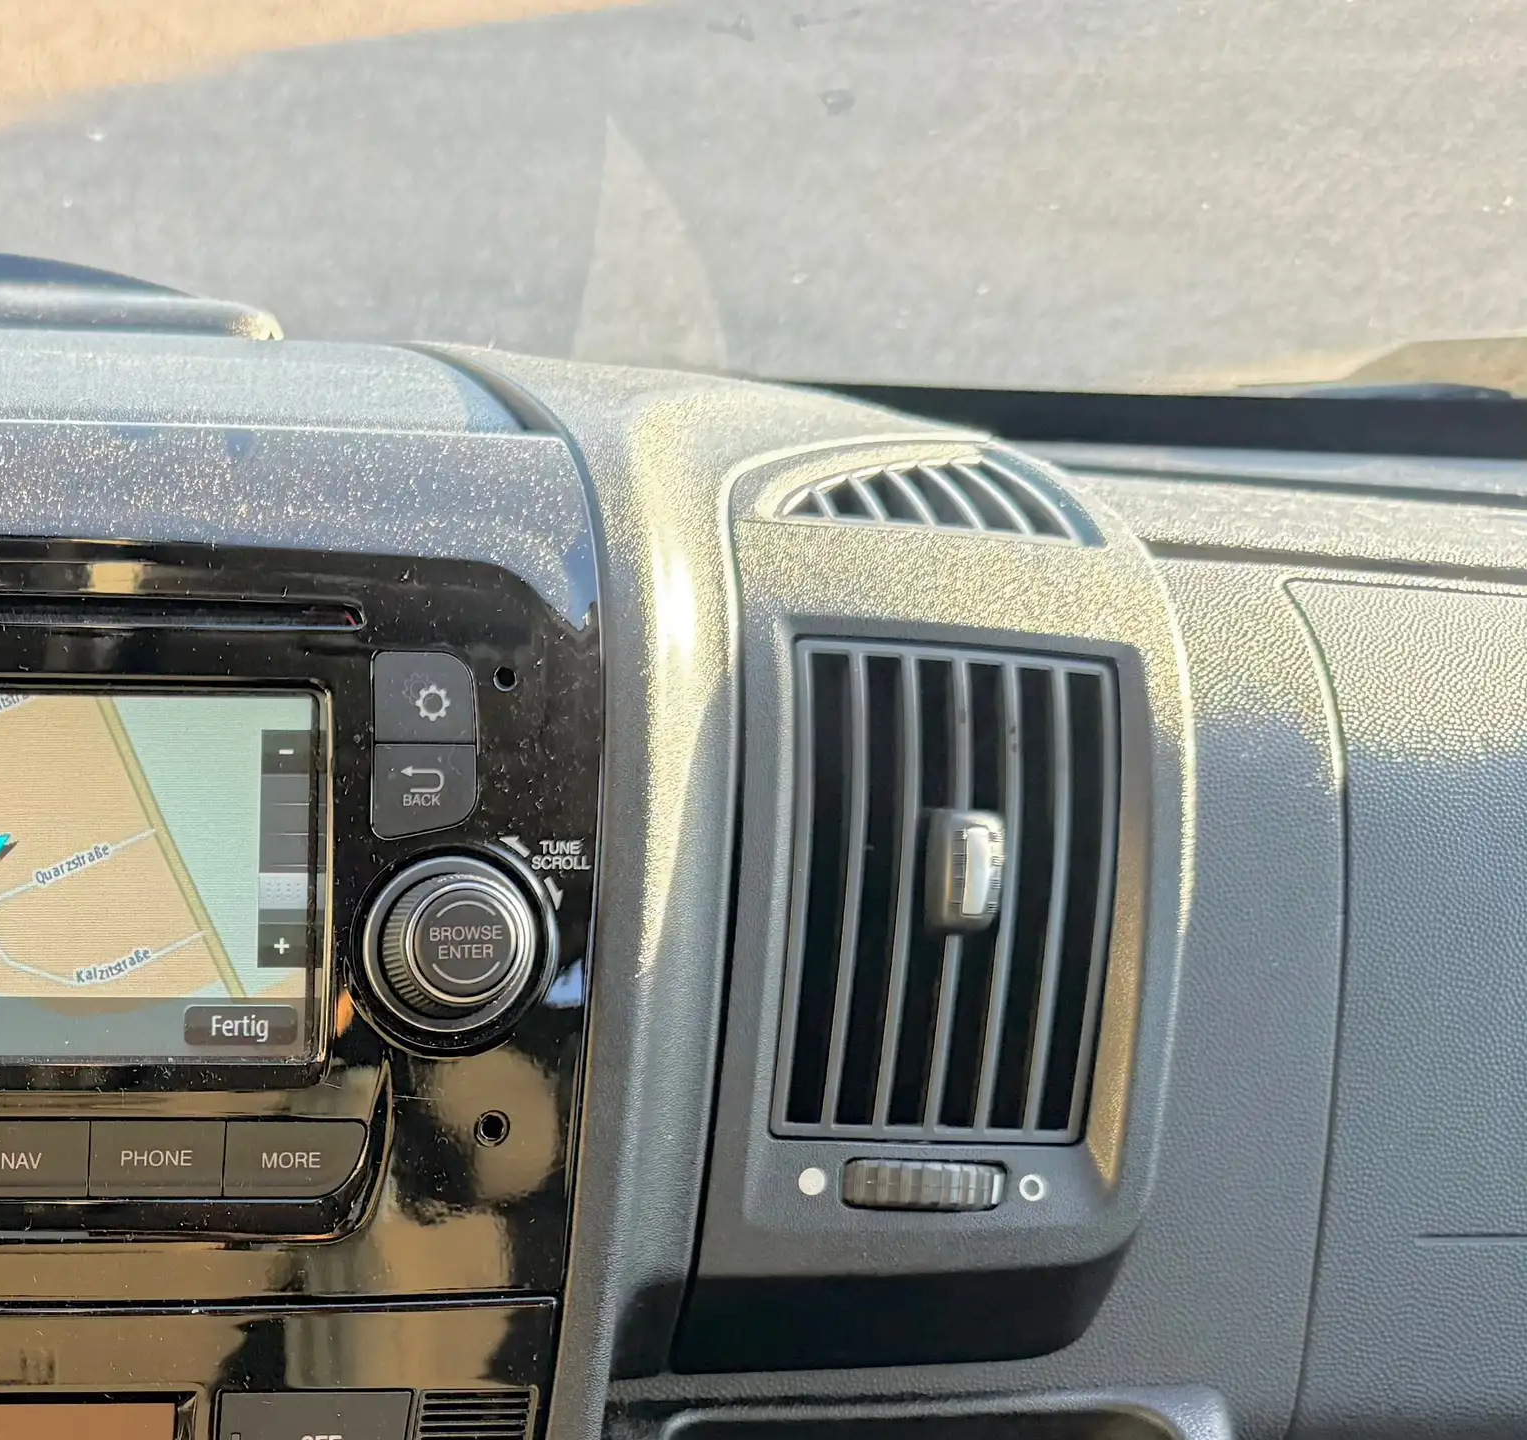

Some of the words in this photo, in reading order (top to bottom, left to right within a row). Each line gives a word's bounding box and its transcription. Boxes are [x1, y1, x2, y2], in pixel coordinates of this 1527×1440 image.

[402, 794, 441, 807] BACK
[539, 840, 581, 855] TUNE
[36, 844, 110, 884] Quarzstraße
[531, 855, 590, 870] SCROLL
[429, 926, 503, 942] BROWSE
[437, 945, 494, 960] ENTER
[75, 948, 151, 983] Kalzitstraße
[211, 1014, 270, 1042] Fertig
[0, 1152, 42, 1170] NAV
[120, 1149, 193, 1168] PHONE
[261, 1151, 321, 1169] MORE
